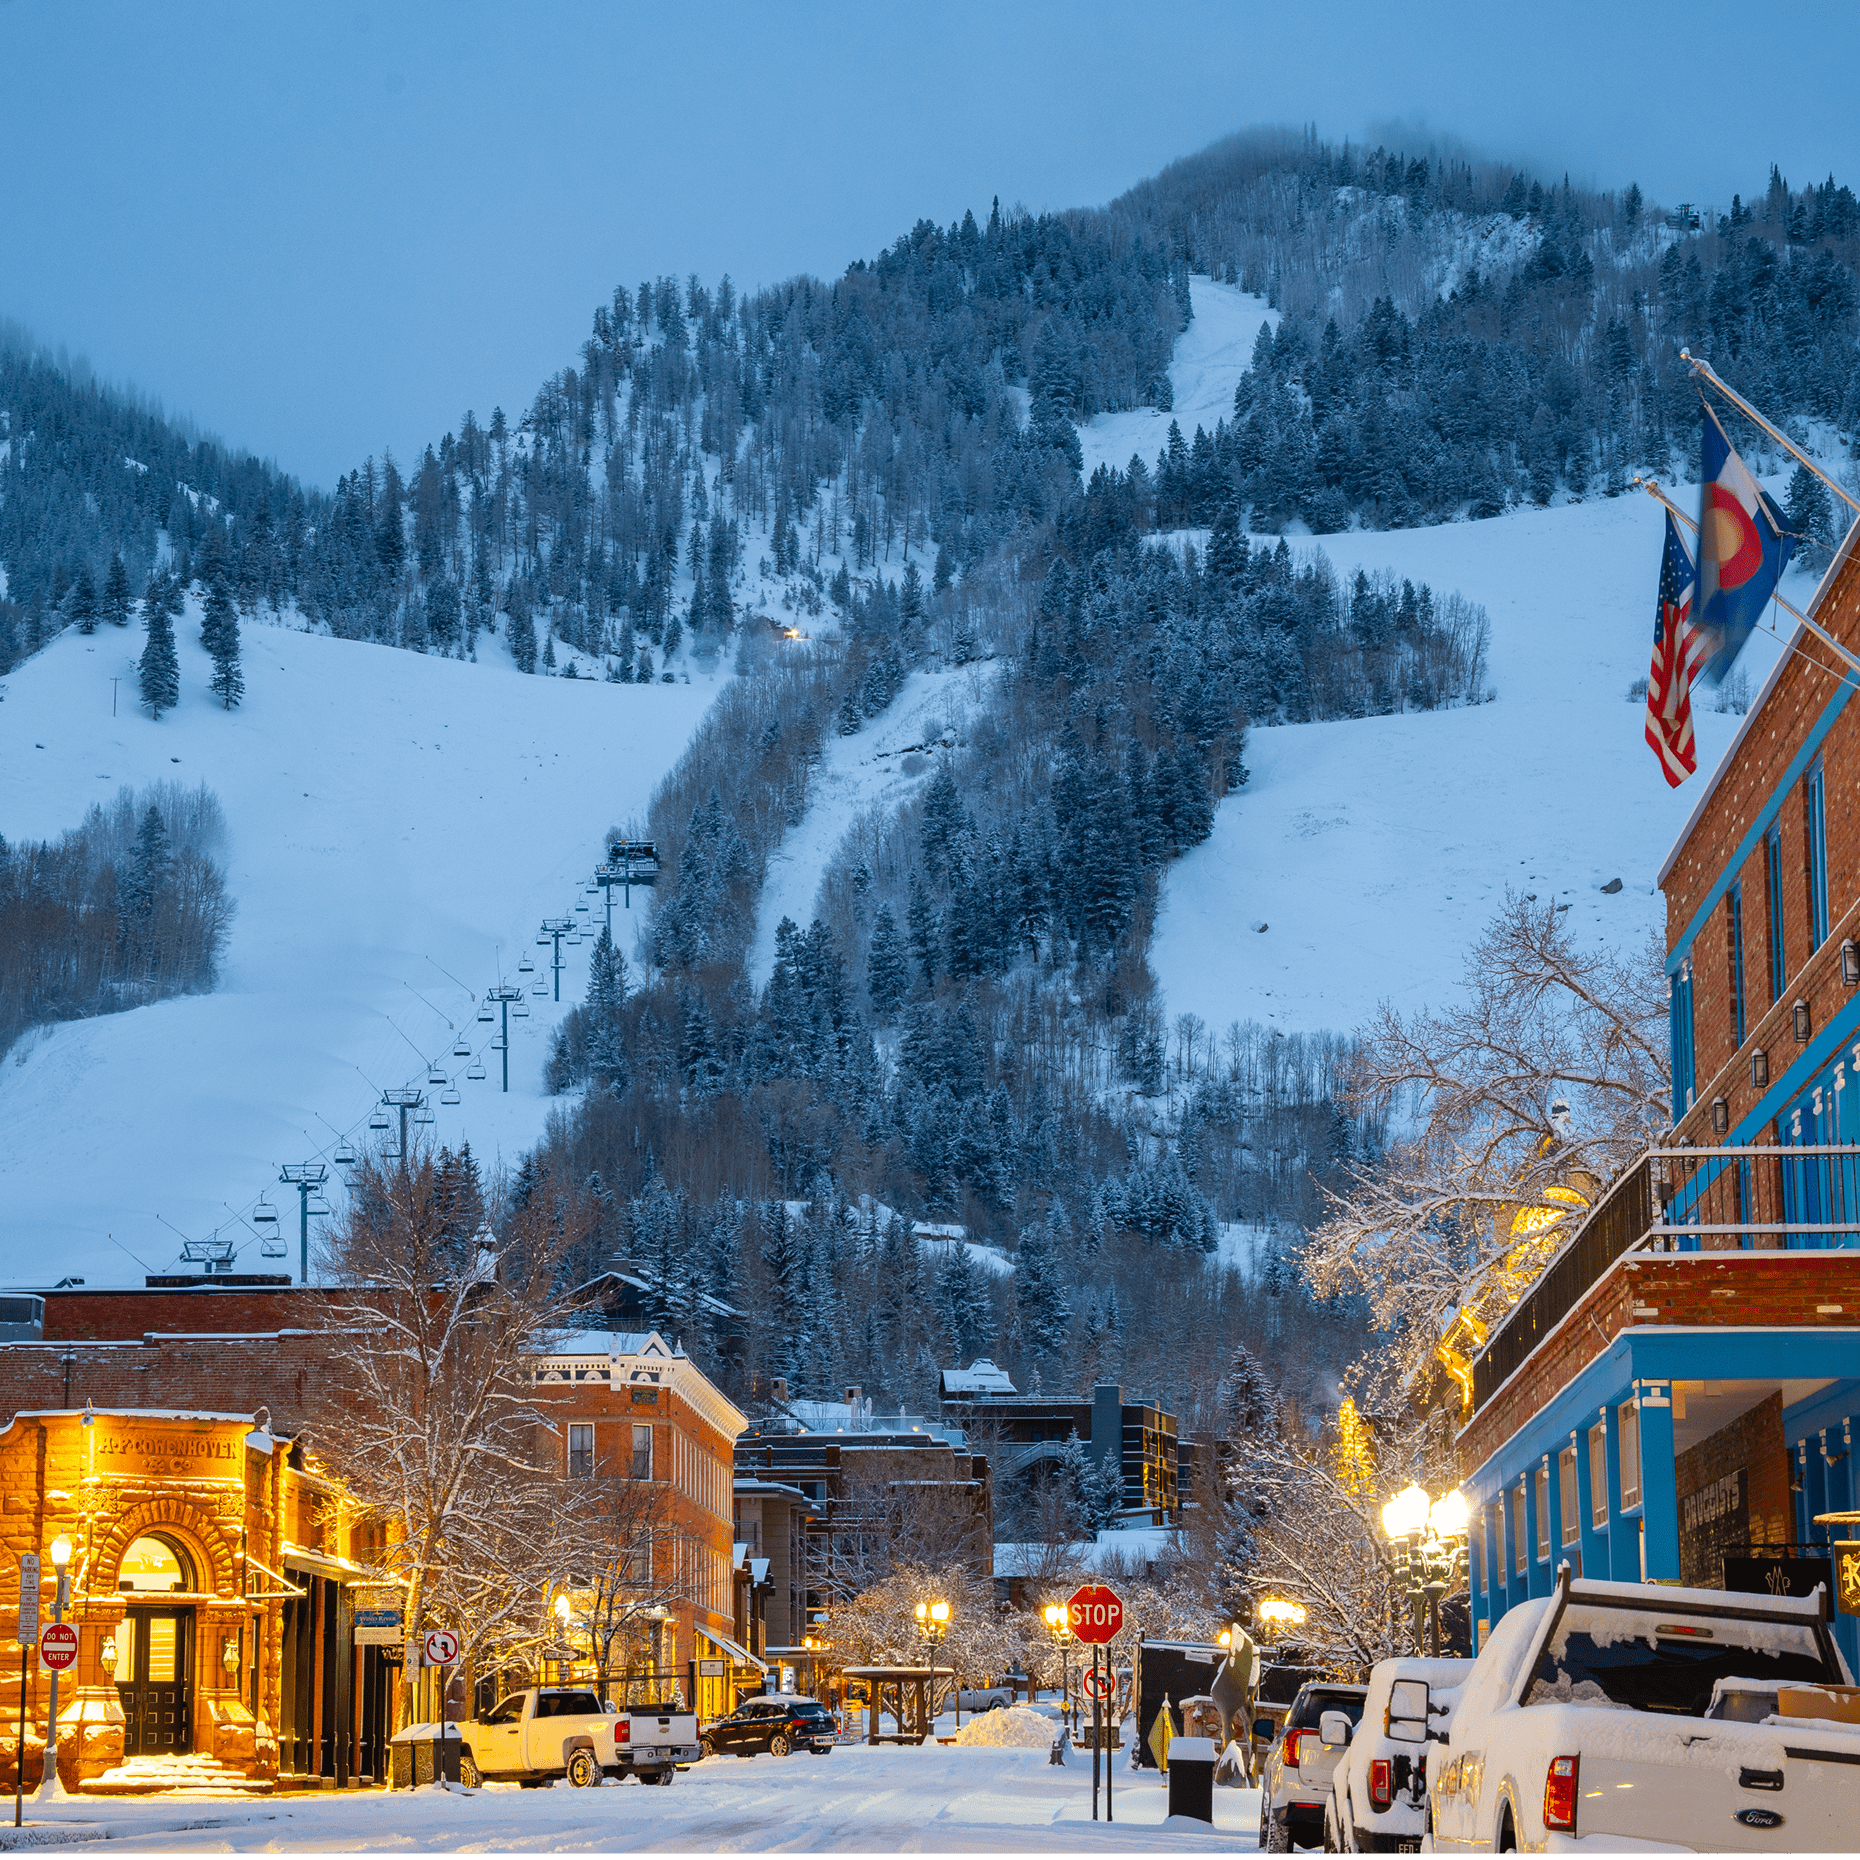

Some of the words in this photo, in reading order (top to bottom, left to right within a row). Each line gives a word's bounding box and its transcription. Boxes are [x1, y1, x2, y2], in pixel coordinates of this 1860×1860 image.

[27, 1557, 35, 1566] NO
[22, 1566, 39, 1574] PARKING
[1071, 1603, 1120, 1626] STOP
[46, 1632, 56, 1641] DO
[59, 1633, 74, 1641] NOT
[48, 1652, 70, 1661] ENTER
[1746, 1811, 1774, 1825] Ford
